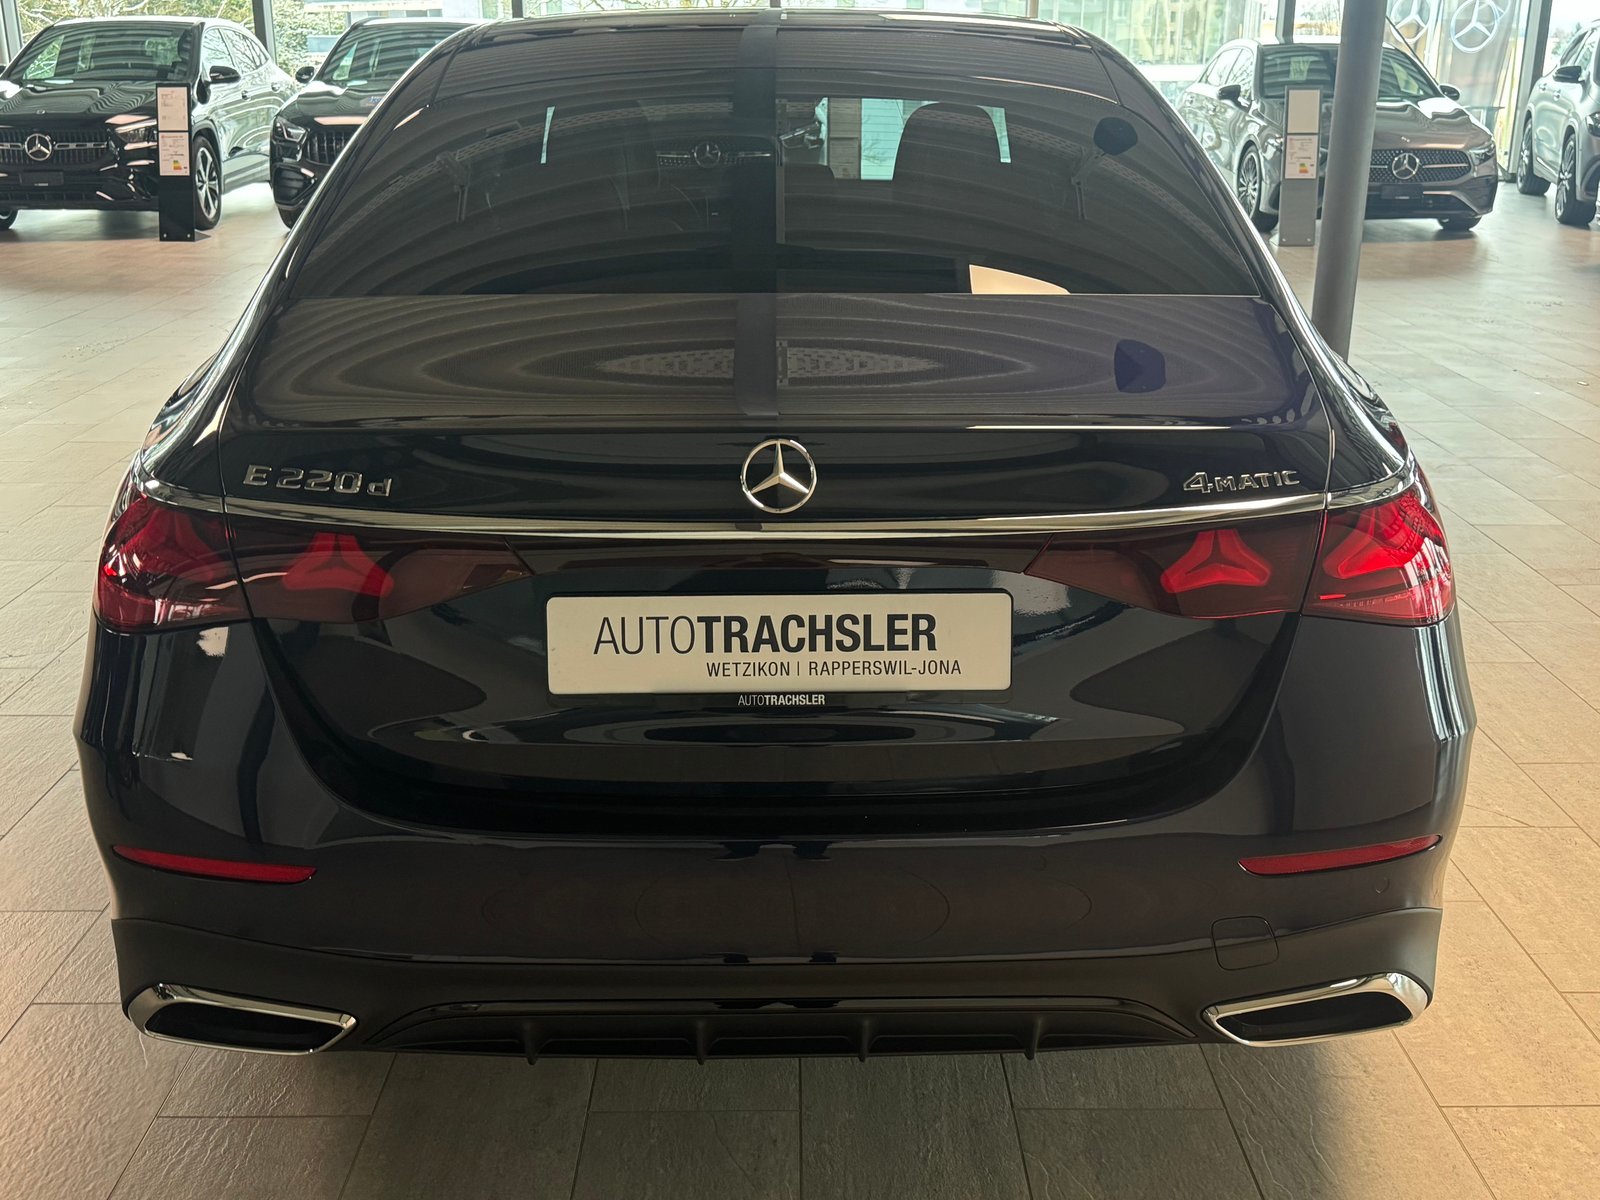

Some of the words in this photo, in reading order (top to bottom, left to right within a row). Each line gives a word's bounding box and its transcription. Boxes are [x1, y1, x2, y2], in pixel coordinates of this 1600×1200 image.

[243, 464, 272, 486] E
[1183, 470, 1300, 494] 4MATIC
[593, 613, 937, 655] AUTOTRACHSLER
[706, 661, 790, 677] WETZIKON
[808, 659, 962, 676] RAPPERSWIL-JONA
[737, 694, 826, 706] AUTOTRACHSLER
